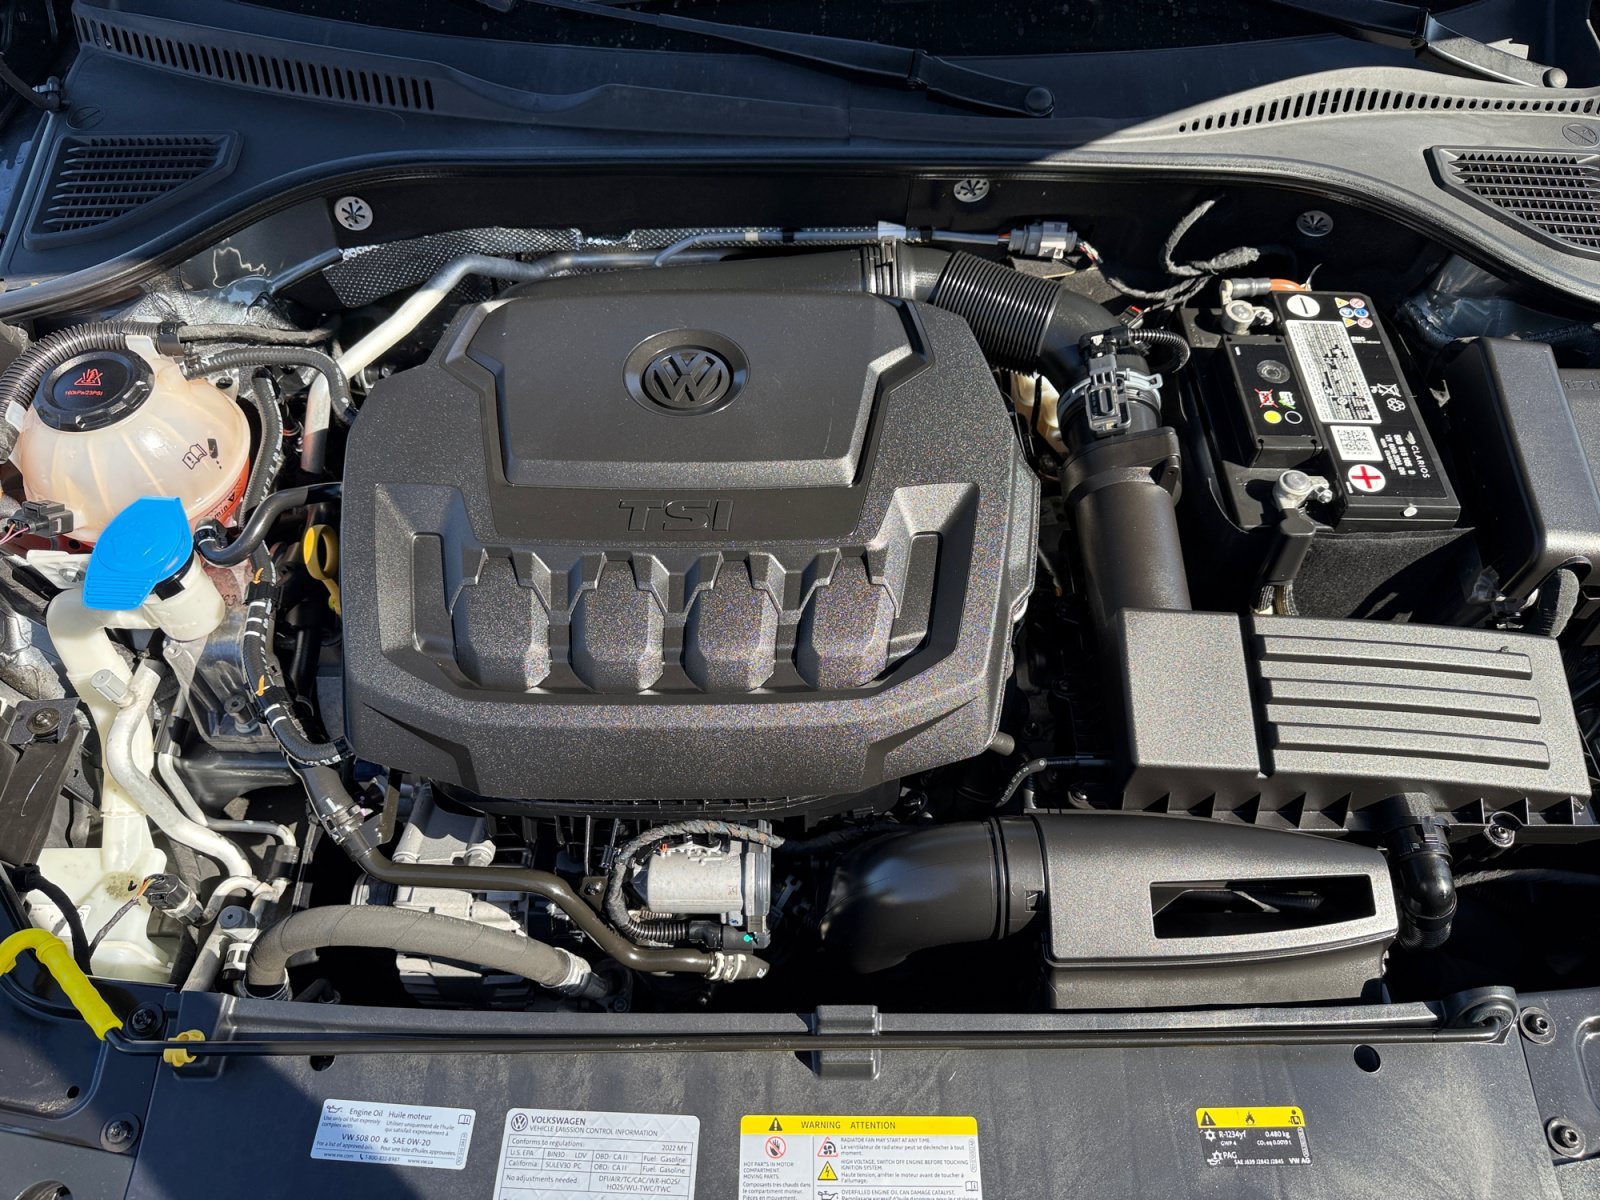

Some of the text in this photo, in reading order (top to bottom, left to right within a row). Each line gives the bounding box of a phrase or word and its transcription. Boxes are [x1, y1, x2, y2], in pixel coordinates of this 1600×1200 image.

[1411, 445, 1430, 478] CLARIOS
[618, 499, 734, 532] TSI
[350, 1108, 372, 1117] Engine
[388, 1111, 406, 1119] Huile
[531, 1116, 586, 1126] VOLKSWAGEN
[801, 1121, 840, 1129] WARNING
[615, 1128, 658, 1137] INFORMATION
[1219, 1130, 1246, 1140] R-1234yf
